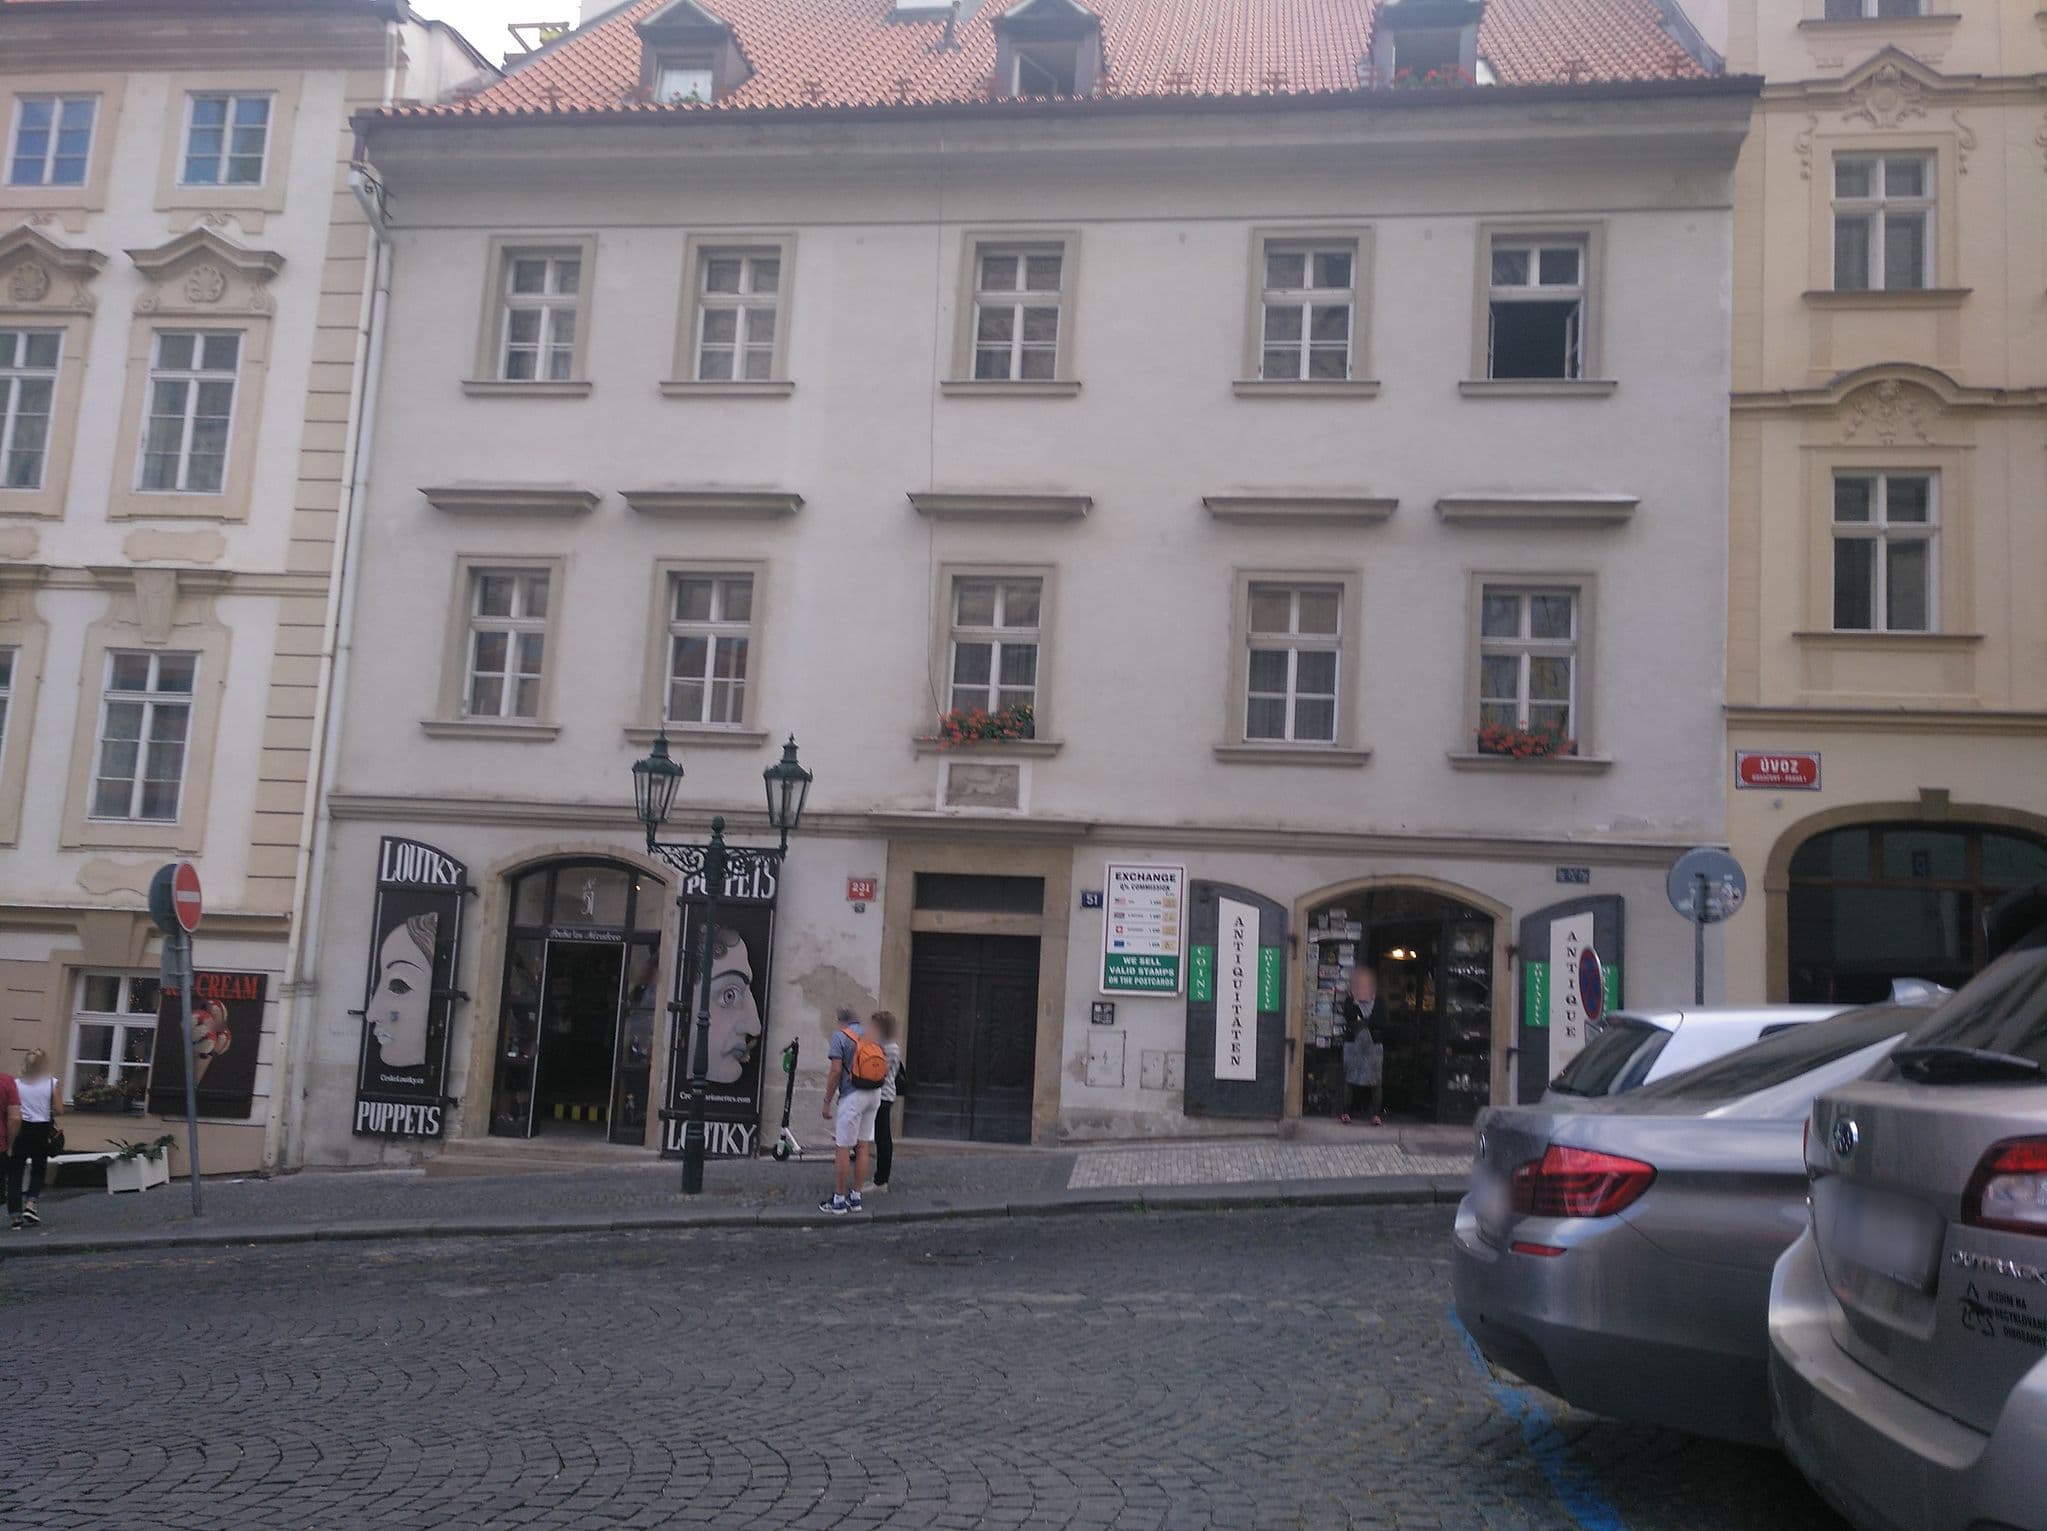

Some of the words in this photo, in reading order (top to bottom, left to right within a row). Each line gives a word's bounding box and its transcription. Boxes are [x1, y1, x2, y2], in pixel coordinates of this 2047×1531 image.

[1760, 756, 1799, 773] ÚVOZ
[381, 840, 462, 885] LOUTKY
[1114, 872, 1177, 883] EXCHANGE
[1085, 893, 1098, 906] 51
[1122, 956, 1137, 965] WE
[1139, 957, 1162, 967] SELL
[1109, 966, 1136, 975] VALID
[1138, 967, 1175, 977] STAMPS
[1196, 947, 1207, 1000] COINS
[195, 973, 259, 1000] CREAM
[1108, 976, 1118, 985] ON
[1120, 976, 1133, 985] THE
[1134, 976, 1175, 987] POSTCARDS
[1566, 930, 1578, 1037] ANTIQUE
[356, 1101, 441, 1136] PUPPETS
